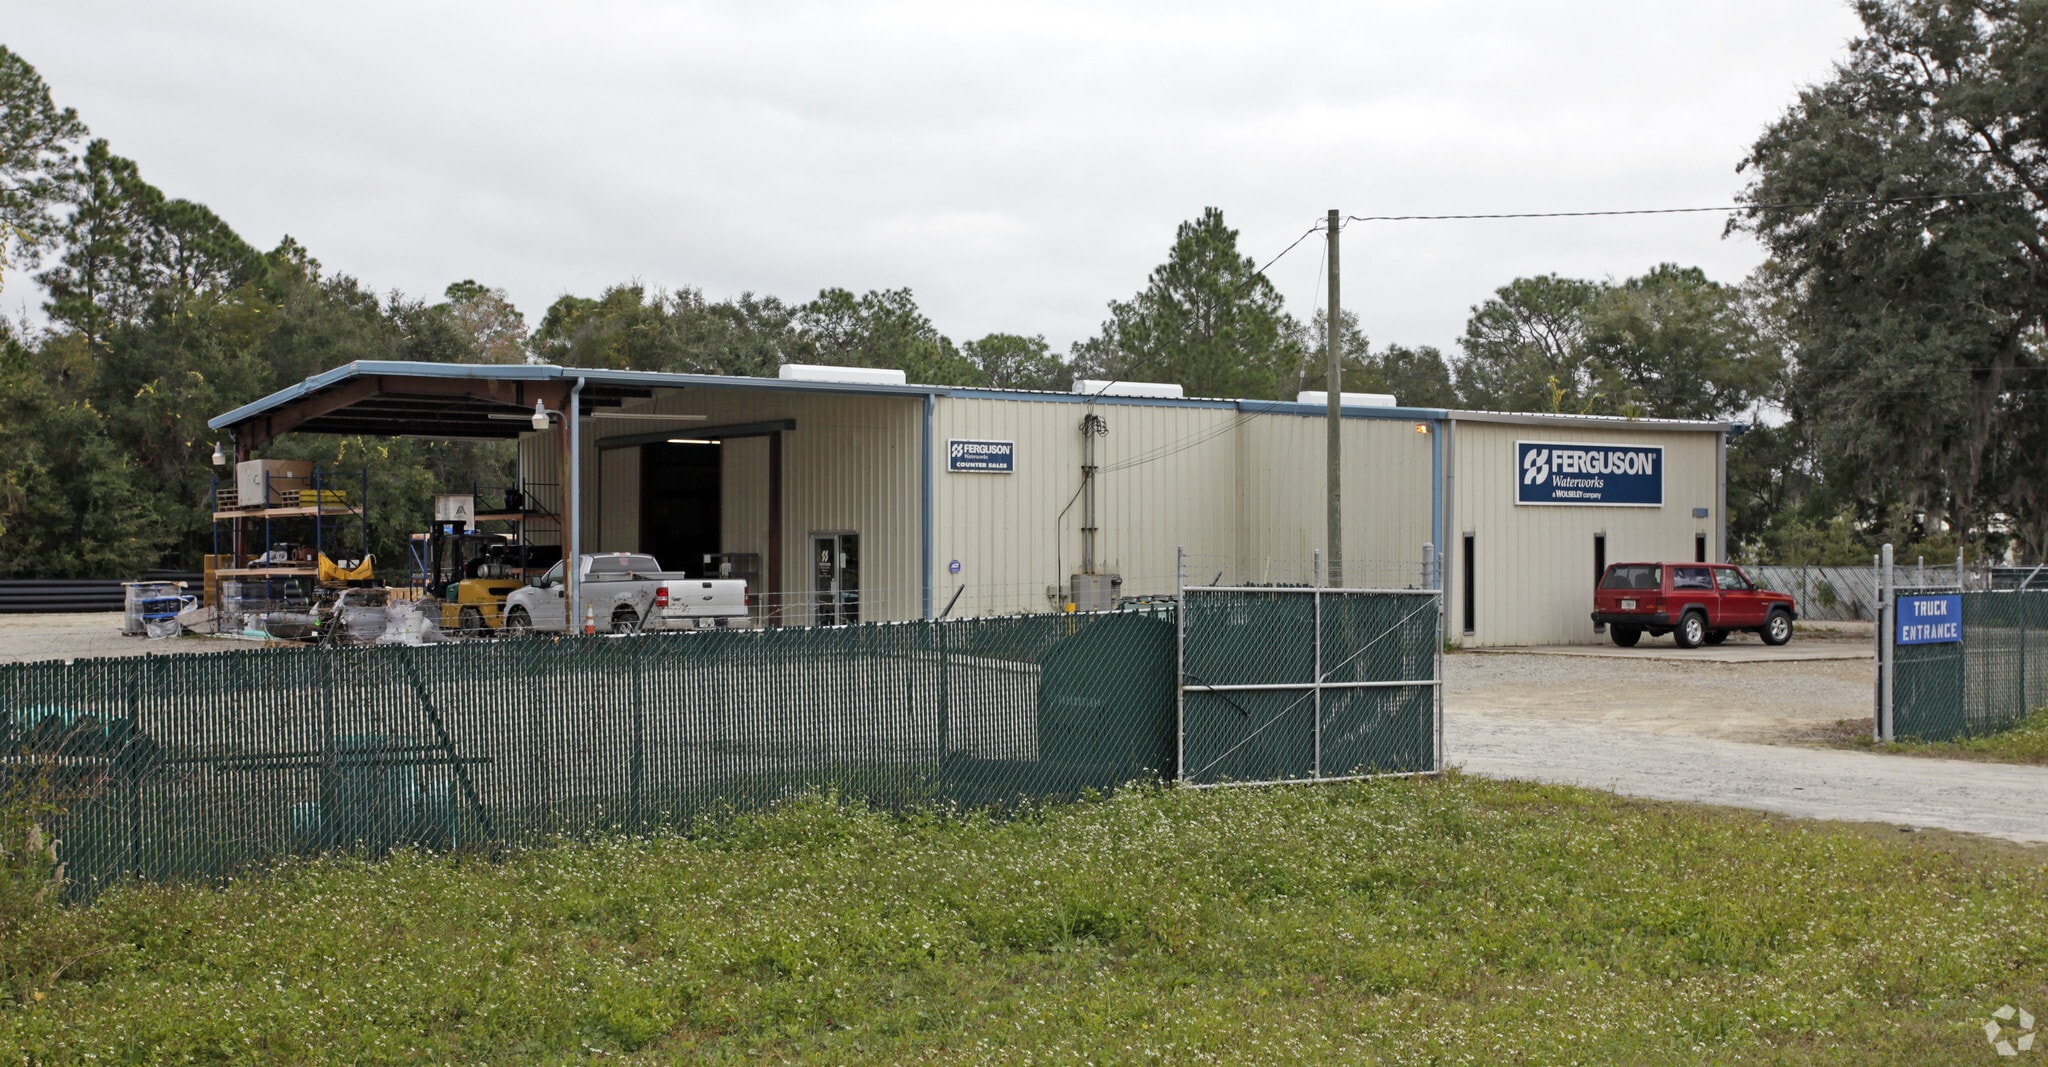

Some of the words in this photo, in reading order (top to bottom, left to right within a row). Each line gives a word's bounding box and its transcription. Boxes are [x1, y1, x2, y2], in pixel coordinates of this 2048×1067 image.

[964, 444, 1010, 454] FERGUSON
[1552, 450, 1653, 475] FERGUSON
[1552, 475, 1604, 488] Waterworks
[1556, 489, 1583, 498] WOLSELEY
[1914, 600, 1947, 616] TRUCK
[1903, 623, 1957, 641] ENTRANCE
